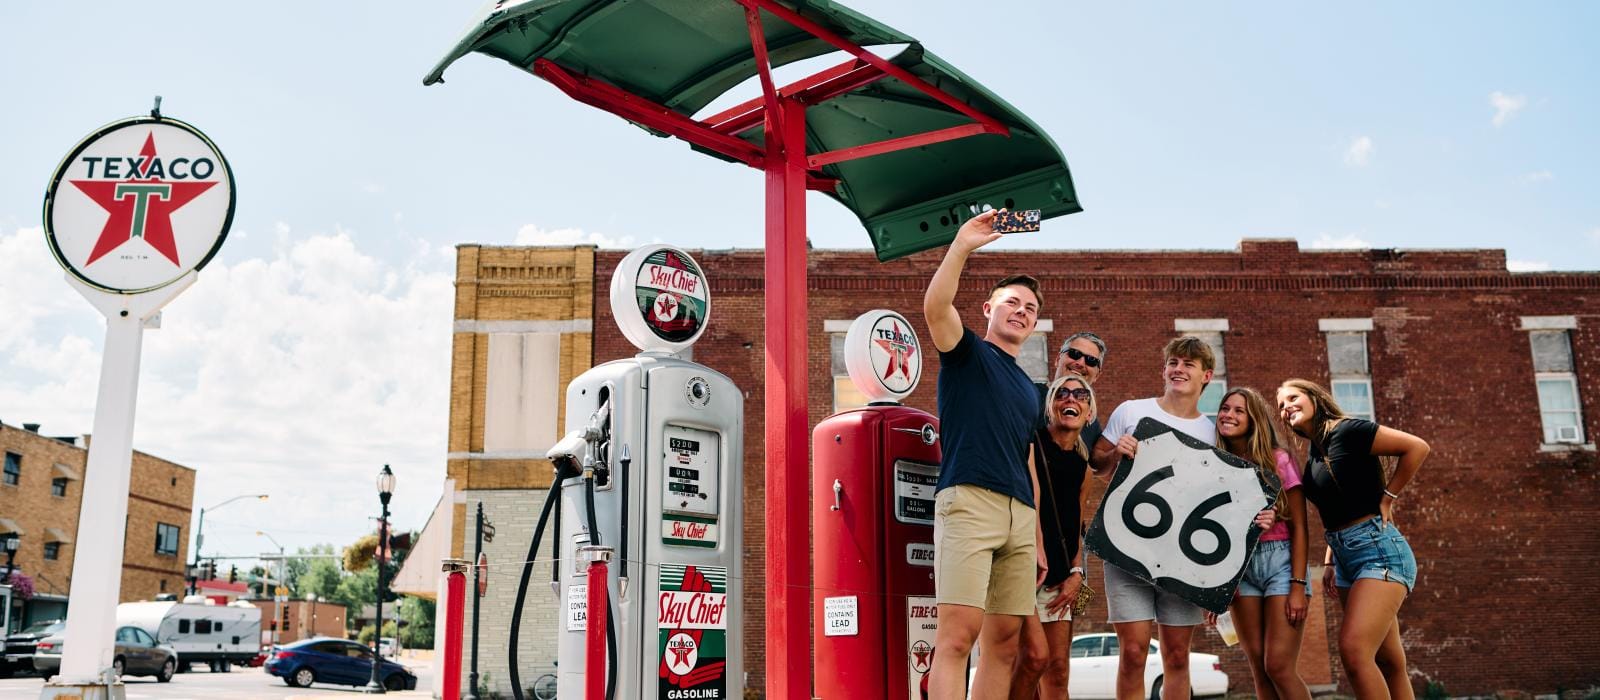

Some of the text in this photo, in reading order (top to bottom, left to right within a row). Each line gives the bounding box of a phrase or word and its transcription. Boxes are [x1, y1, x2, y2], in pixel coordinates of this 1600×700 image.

[82, 157, 215, 180] TEXACO
[115, 185, 170, 239] T
[650, 265, 698, 294] Sky Chief
[876, 328, 915, 346] TEXACO
[1121, 464, 1232, 567] 66
[671, 520, 708, 540] Sky Chief
[911, 548, 935, 560] FIRE-C
[570, 602, 587, 610] CONTA
[658, 592, 727, 629] Sky Chief
[573, 611, 587, 621] LEA
[827, 610, 854, 619] CONTAINS
[831, 619, 850, 628] LEAD
[670, 640, 694, 648] TEXACO
[667, 688, 719, 700] GASOLINE
